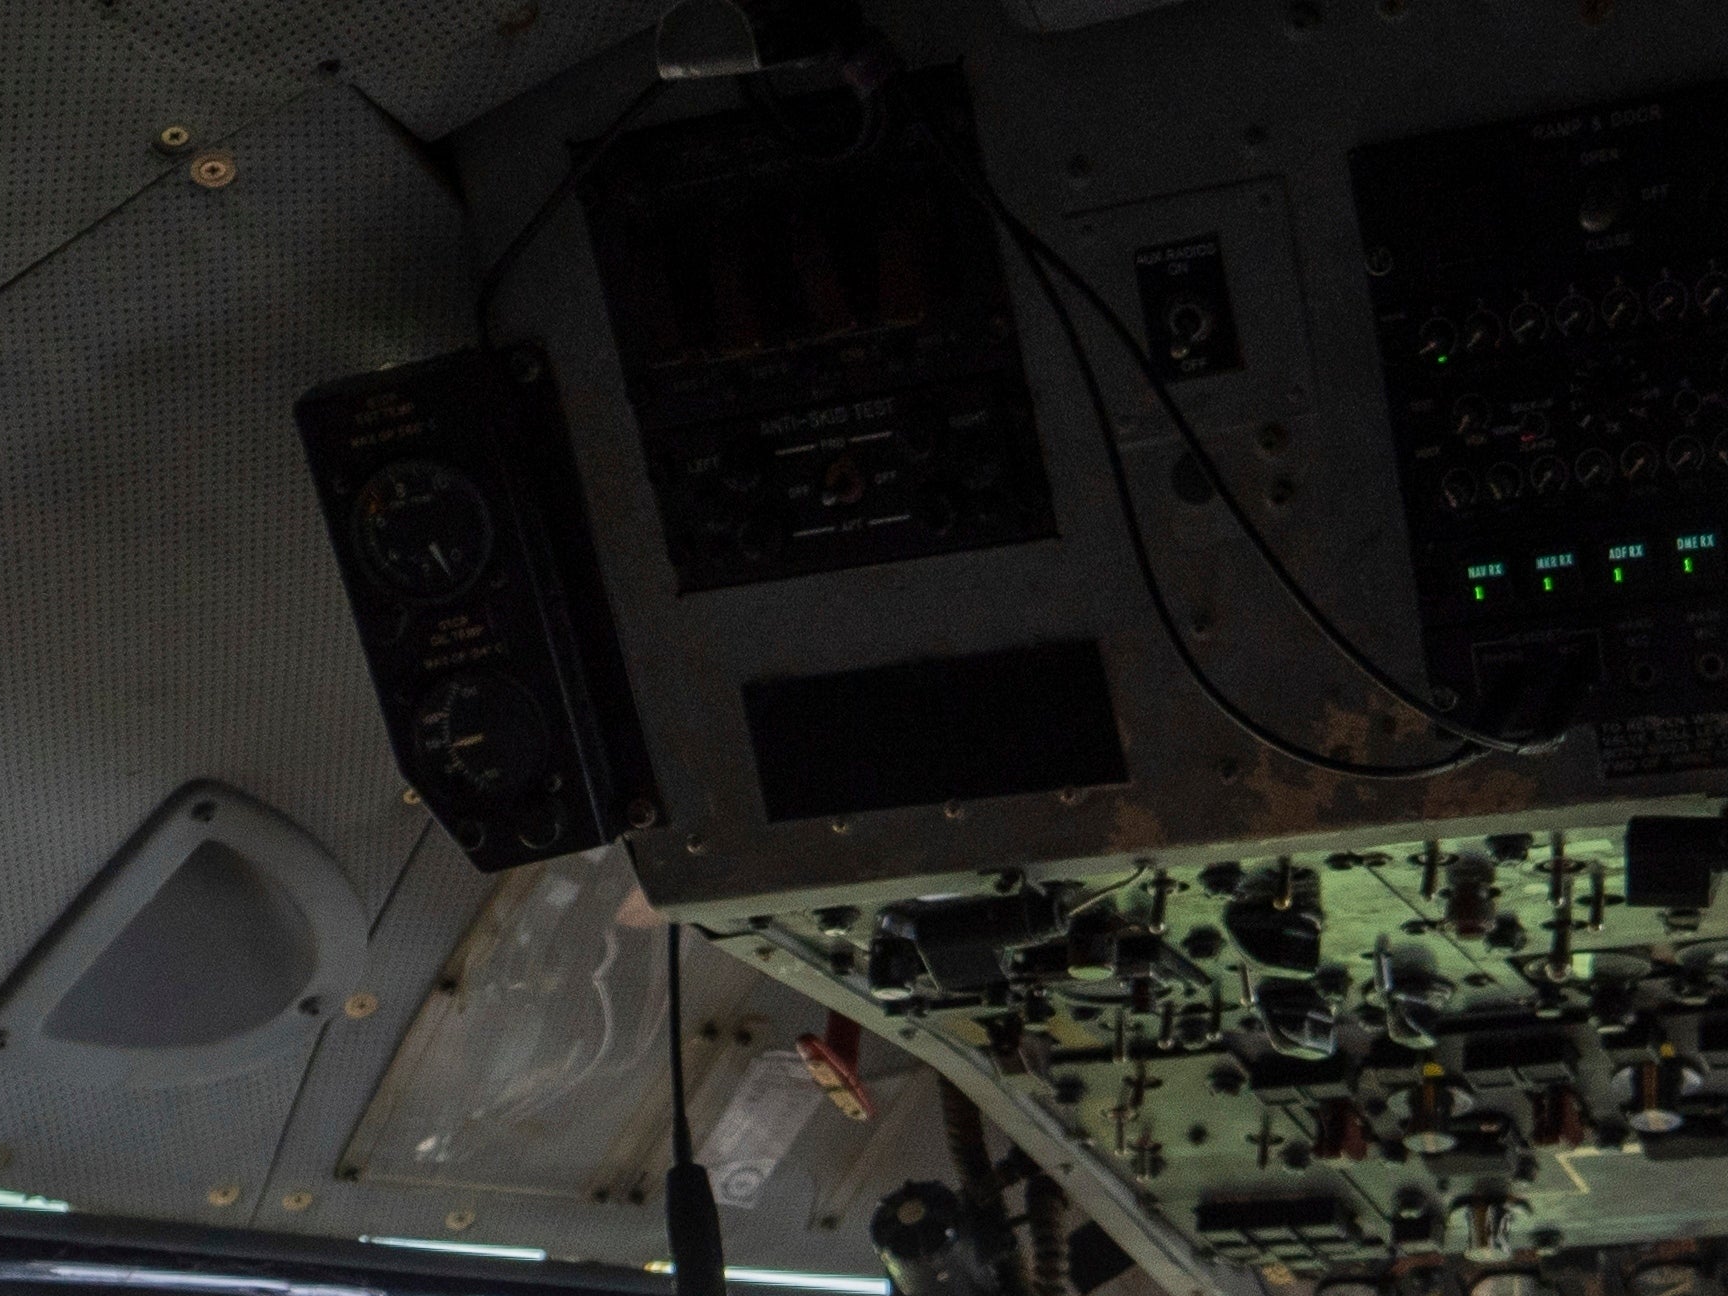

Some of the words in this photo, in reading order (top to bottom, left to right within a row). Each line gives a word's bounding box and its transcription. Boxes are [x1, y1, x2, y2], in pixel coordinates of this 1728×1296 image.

[1167, 262, 1189, 276] ON
[1180, 357, 1207, 372] OFF
[759, 404, 849, 436] ANTI-SKID
[854, 397, 895, 420] TEST
[1677, 537, 1698, 550] DME
[1700, 535, 1714, 547] RX
[1609, 547, 1627, 560] ADF
[1629, 545, 1643, 557] RX
[1559, 554, 1573, 567] RX
[1489, 564, 1502, 577] RX
